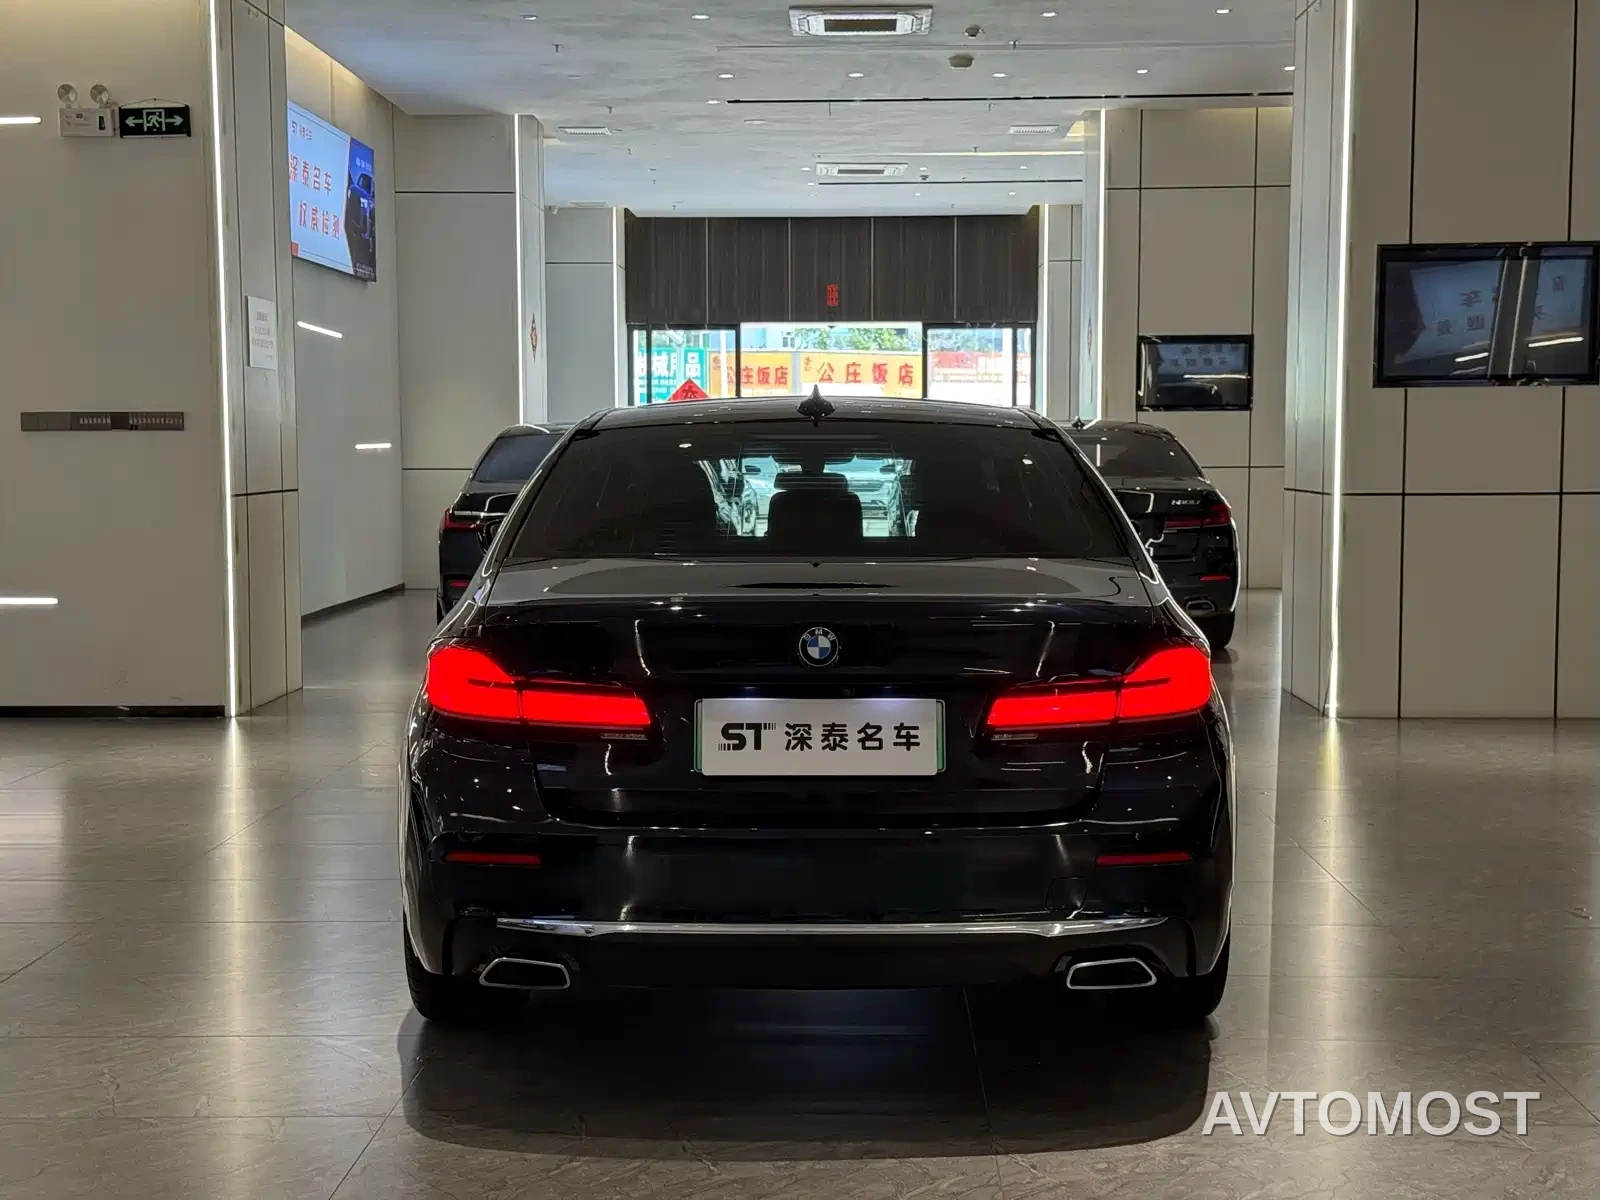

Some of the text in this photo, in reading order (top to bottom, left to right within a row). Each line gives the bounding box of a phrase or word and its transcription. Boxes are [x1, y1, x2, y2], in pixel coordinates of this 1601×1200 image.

[288, 153, 332, 197] 深泰名车
[299, 200, 340, 240] 权威检测
[816, 361, 914, 386] 公庄饭店
[719, 722, 921, 752] ST 深泰名车
